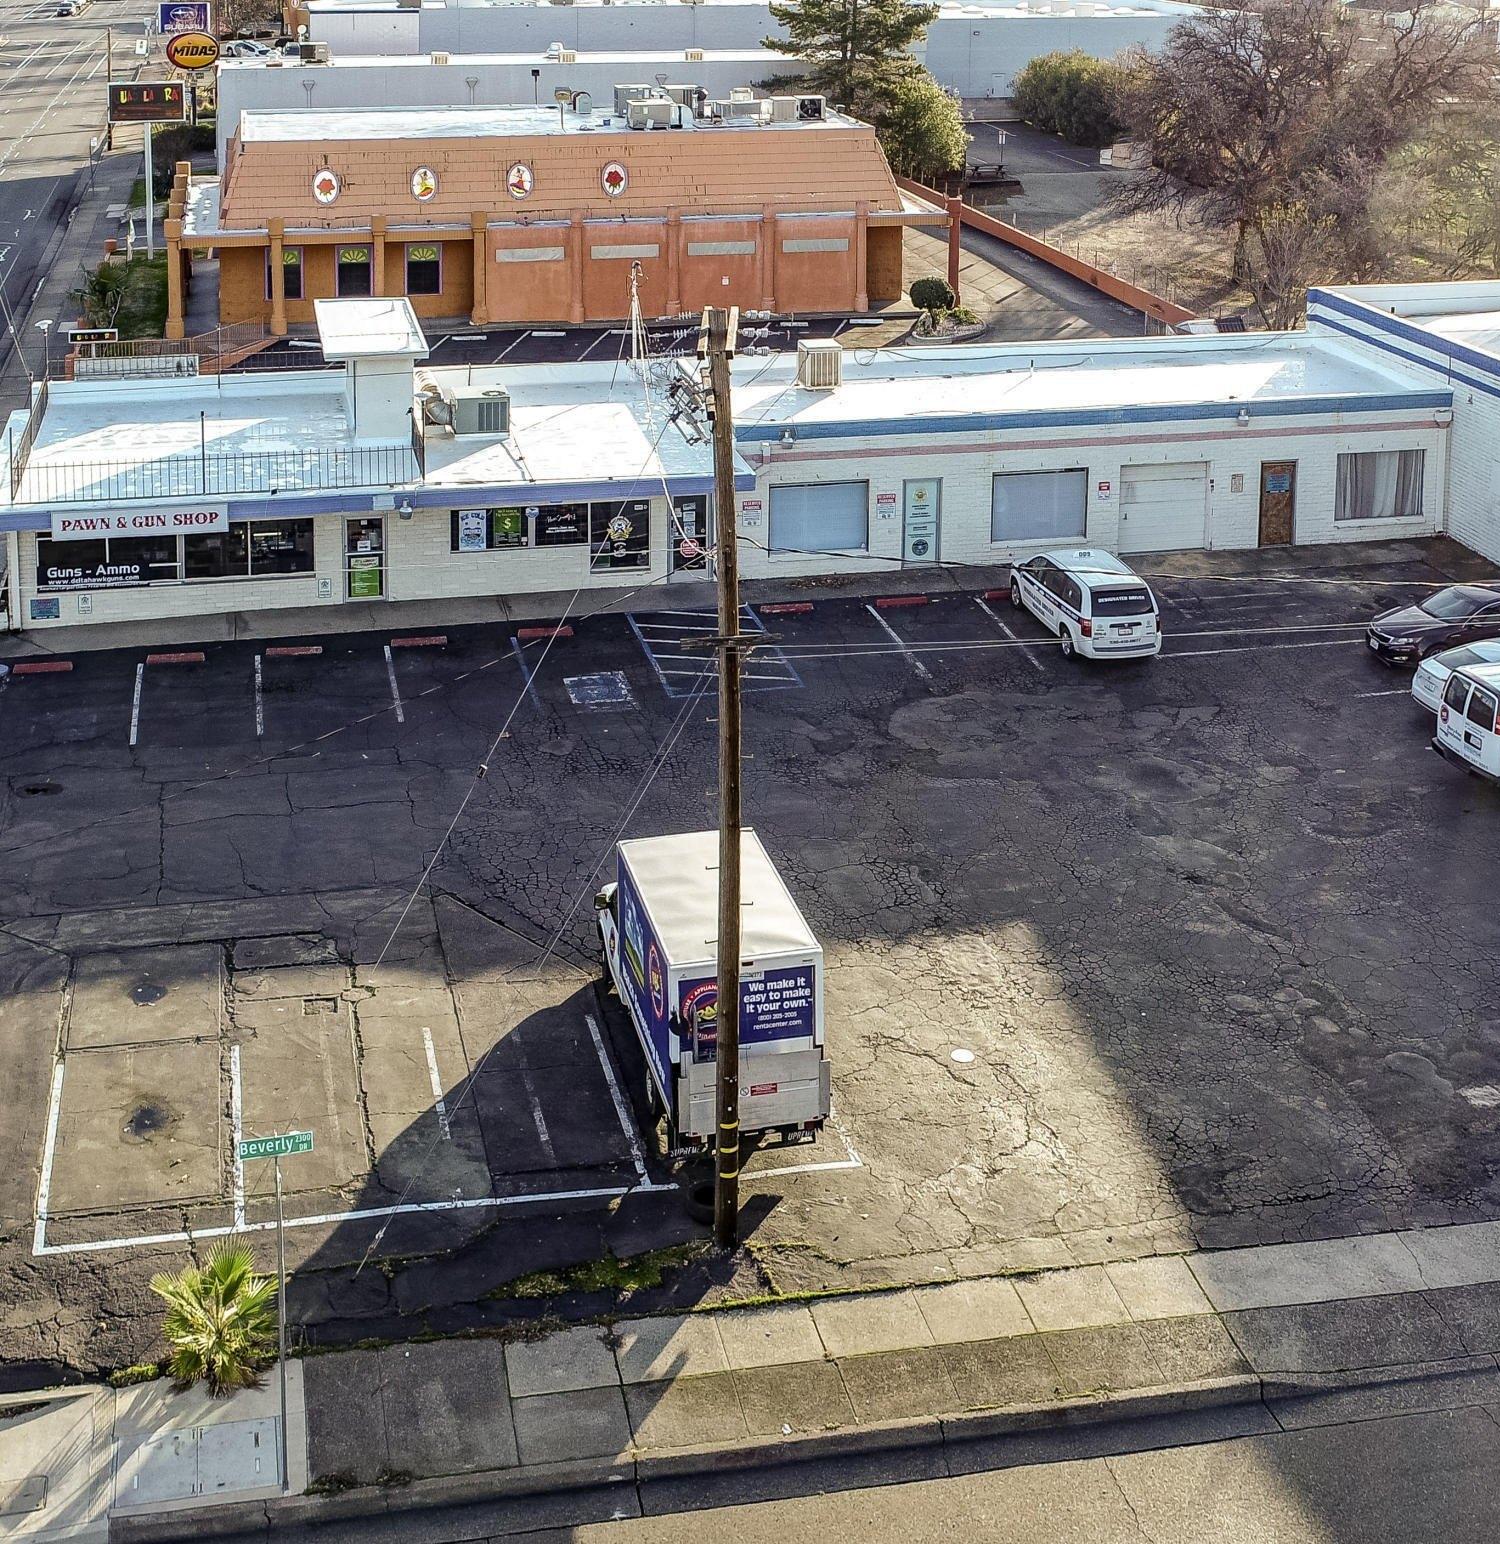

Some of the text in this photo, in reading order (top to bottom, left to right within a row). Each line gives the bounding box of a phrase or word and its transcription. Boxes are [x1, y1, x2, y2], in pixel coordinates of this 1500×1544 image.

[173, 45, 216, 57] MIDAS
[61, 511, 220, 532] PAWN & GUN SHOP
[47, 566, 82, 578] Guns
[96, 564, 140, 576] Ammo
[48, 574, 140, 585] www.deltahawkguns.com
[748, 976, 806, 992] We make it
[743, 987, 811, 1003] easy to make
[746, 998, 809, 1013] it your own.
[753, 1019, 803, 1031] rentacenter.com
[295, 1133, 311, 1143] 2300
[240, 1137, 294, 1155] Beverly
[299, 1143, 308, 1151] DR
